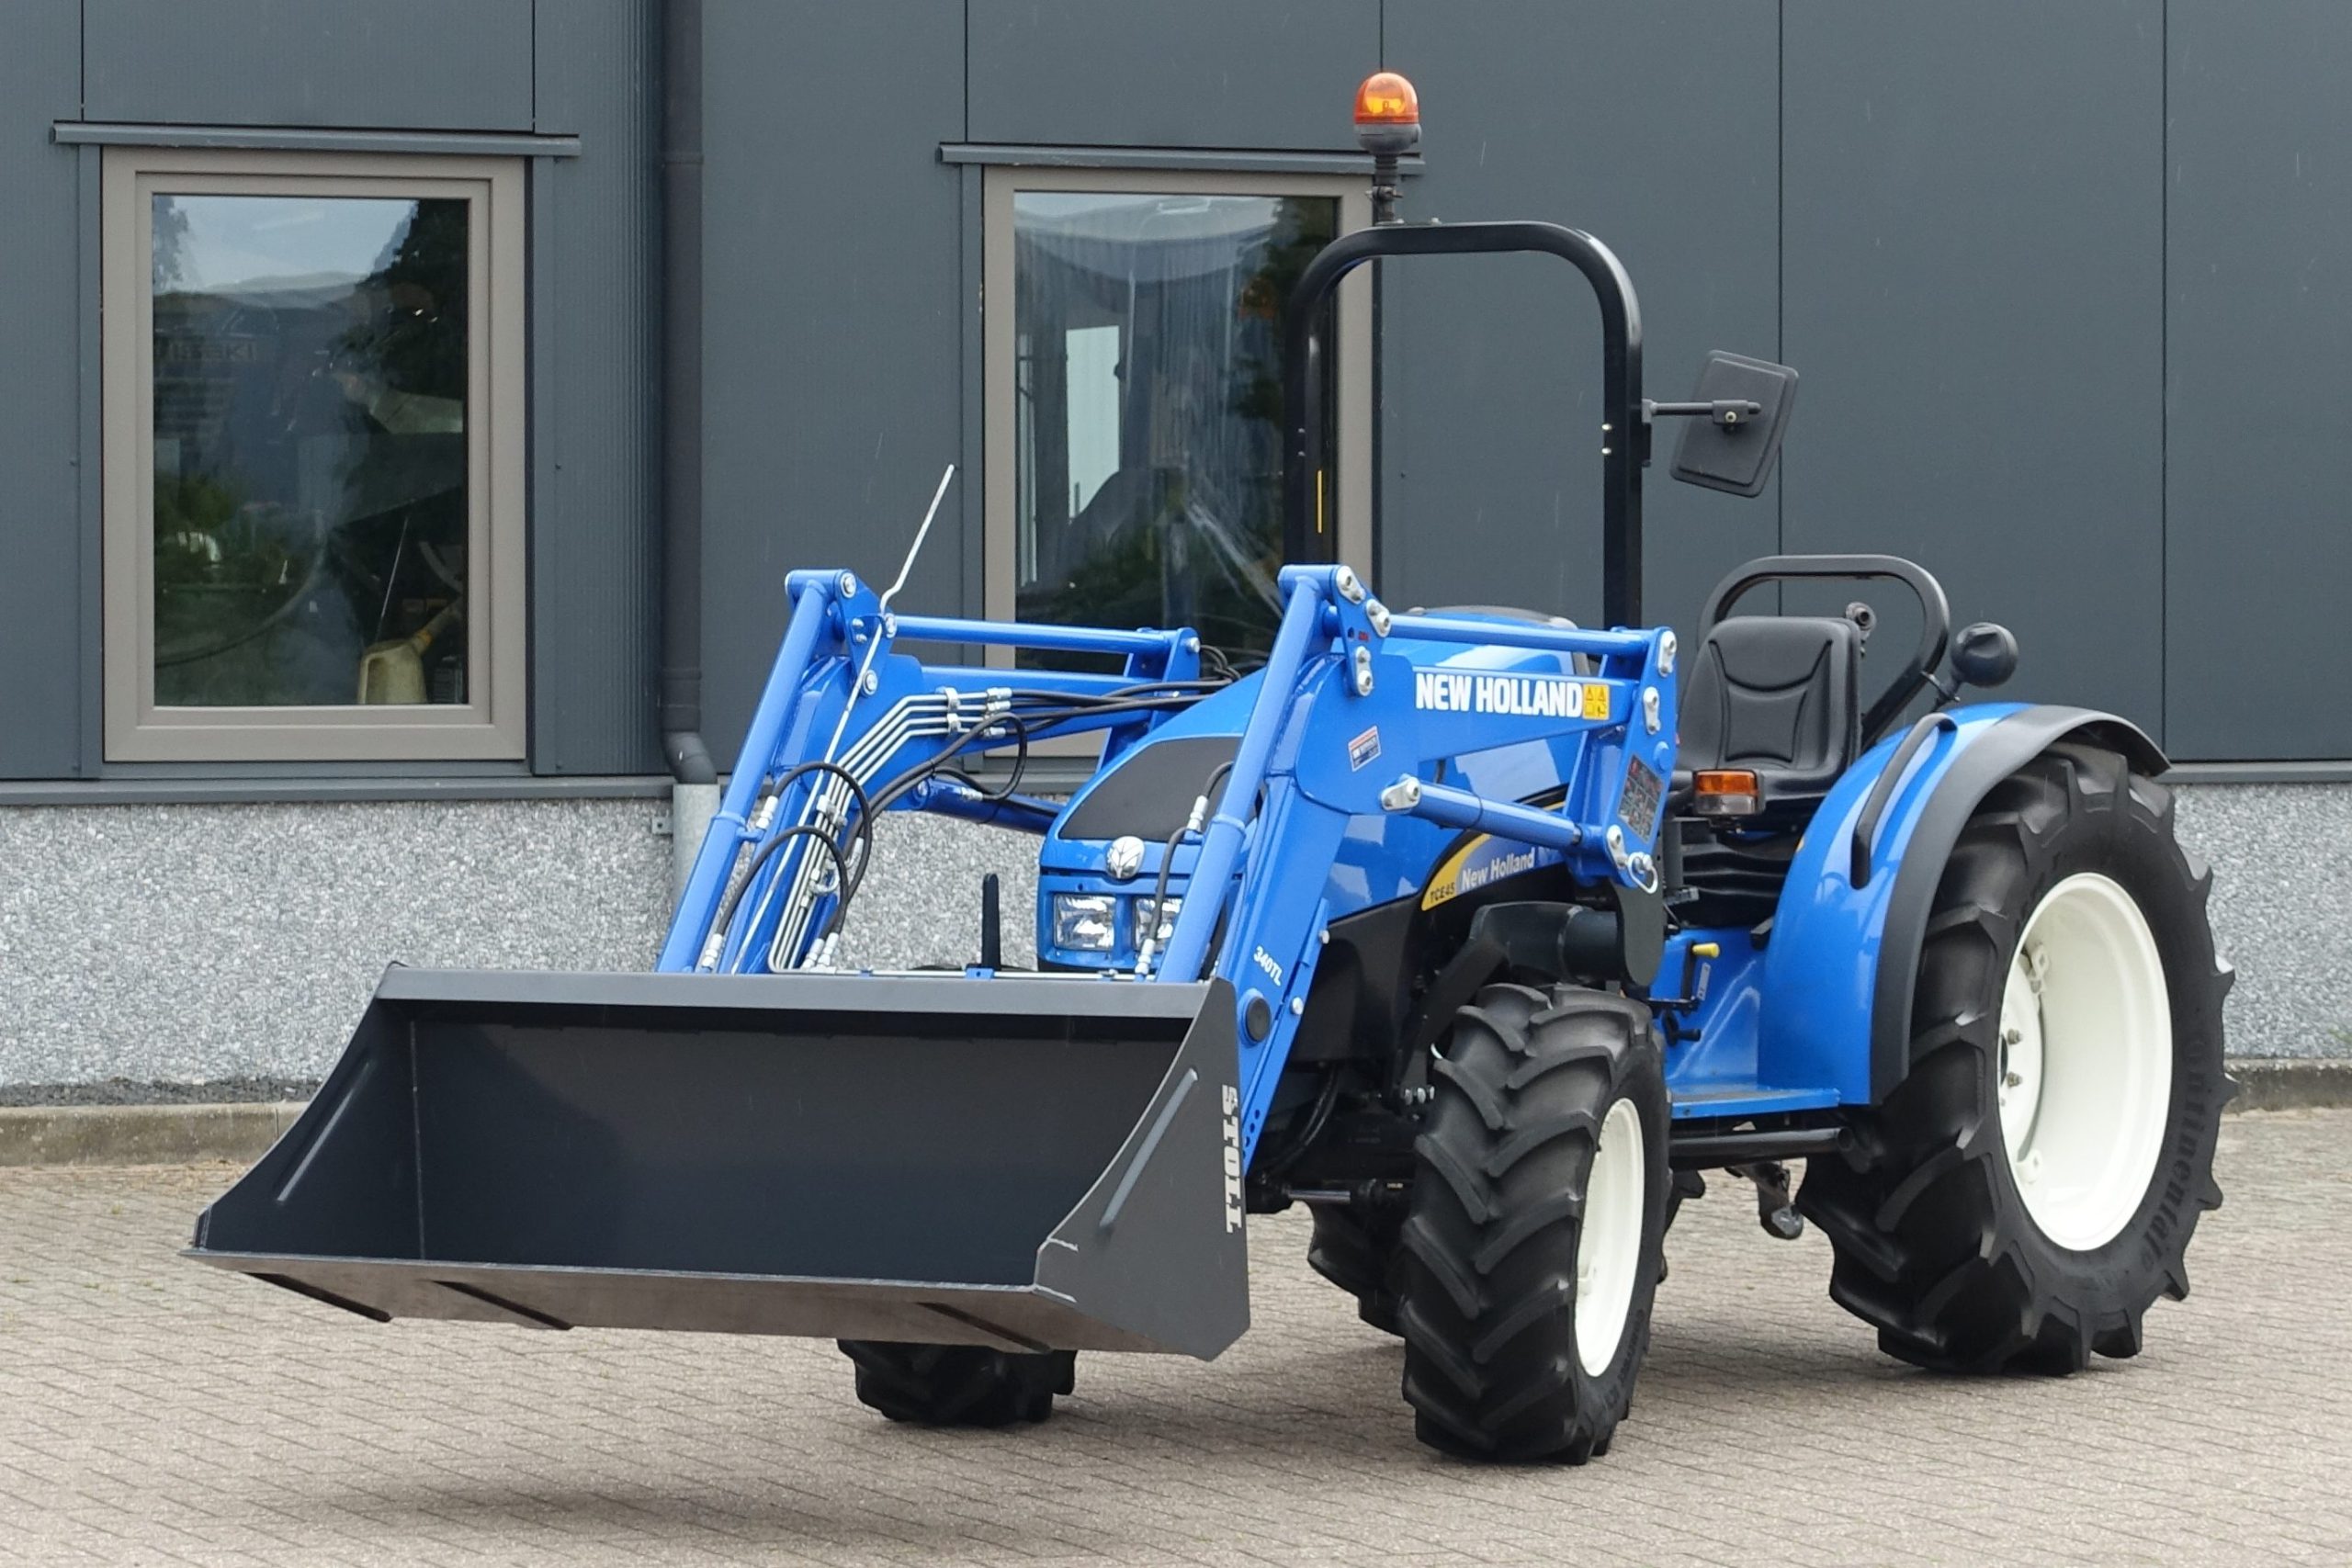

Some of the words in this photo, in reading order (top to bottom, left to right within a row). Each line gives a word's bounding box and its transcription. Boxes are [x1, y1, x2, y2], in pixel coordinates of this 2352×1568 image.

[1416, 673, 1472, 712] NEW
[1476, 677, 1583, 717] HOLLAND
[1463, 868, 1489, 890] New
[1490, 847, 1535, 880] Holland
[1430, 883, 1455, 903] TCE45
[1253, 945, 1282, 987] 340TL
[1222, 1084, 1242, 1233] STOLL
